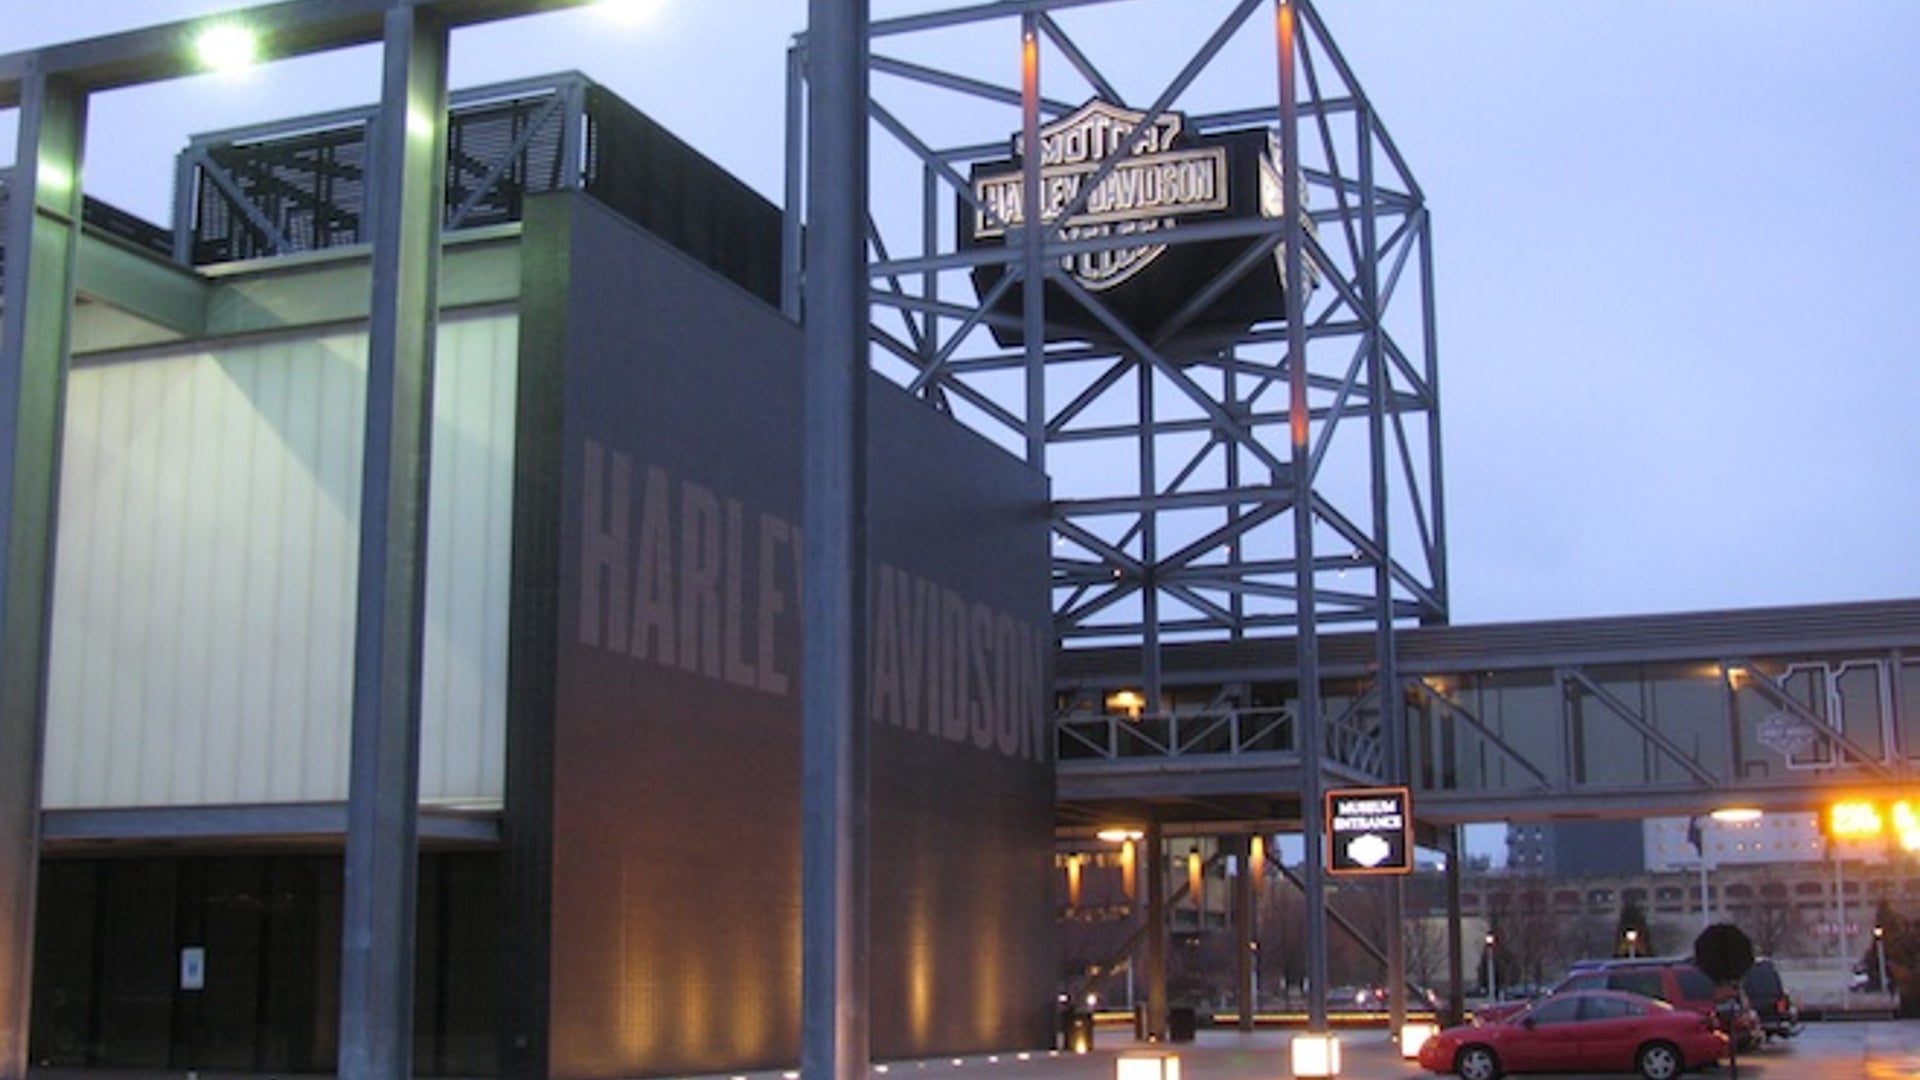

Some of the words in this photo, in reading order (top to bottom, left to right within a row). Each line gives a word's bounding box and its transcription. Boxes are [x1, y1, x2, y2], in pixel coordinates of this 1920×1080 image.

[579, 438, 803, 695] HARLE
[872, 562, 1046, 763] AVIDSON
[1338, 800, 1397, 815] MUSEUM
[1333, 815, 1401, 831] ENTRANCE
